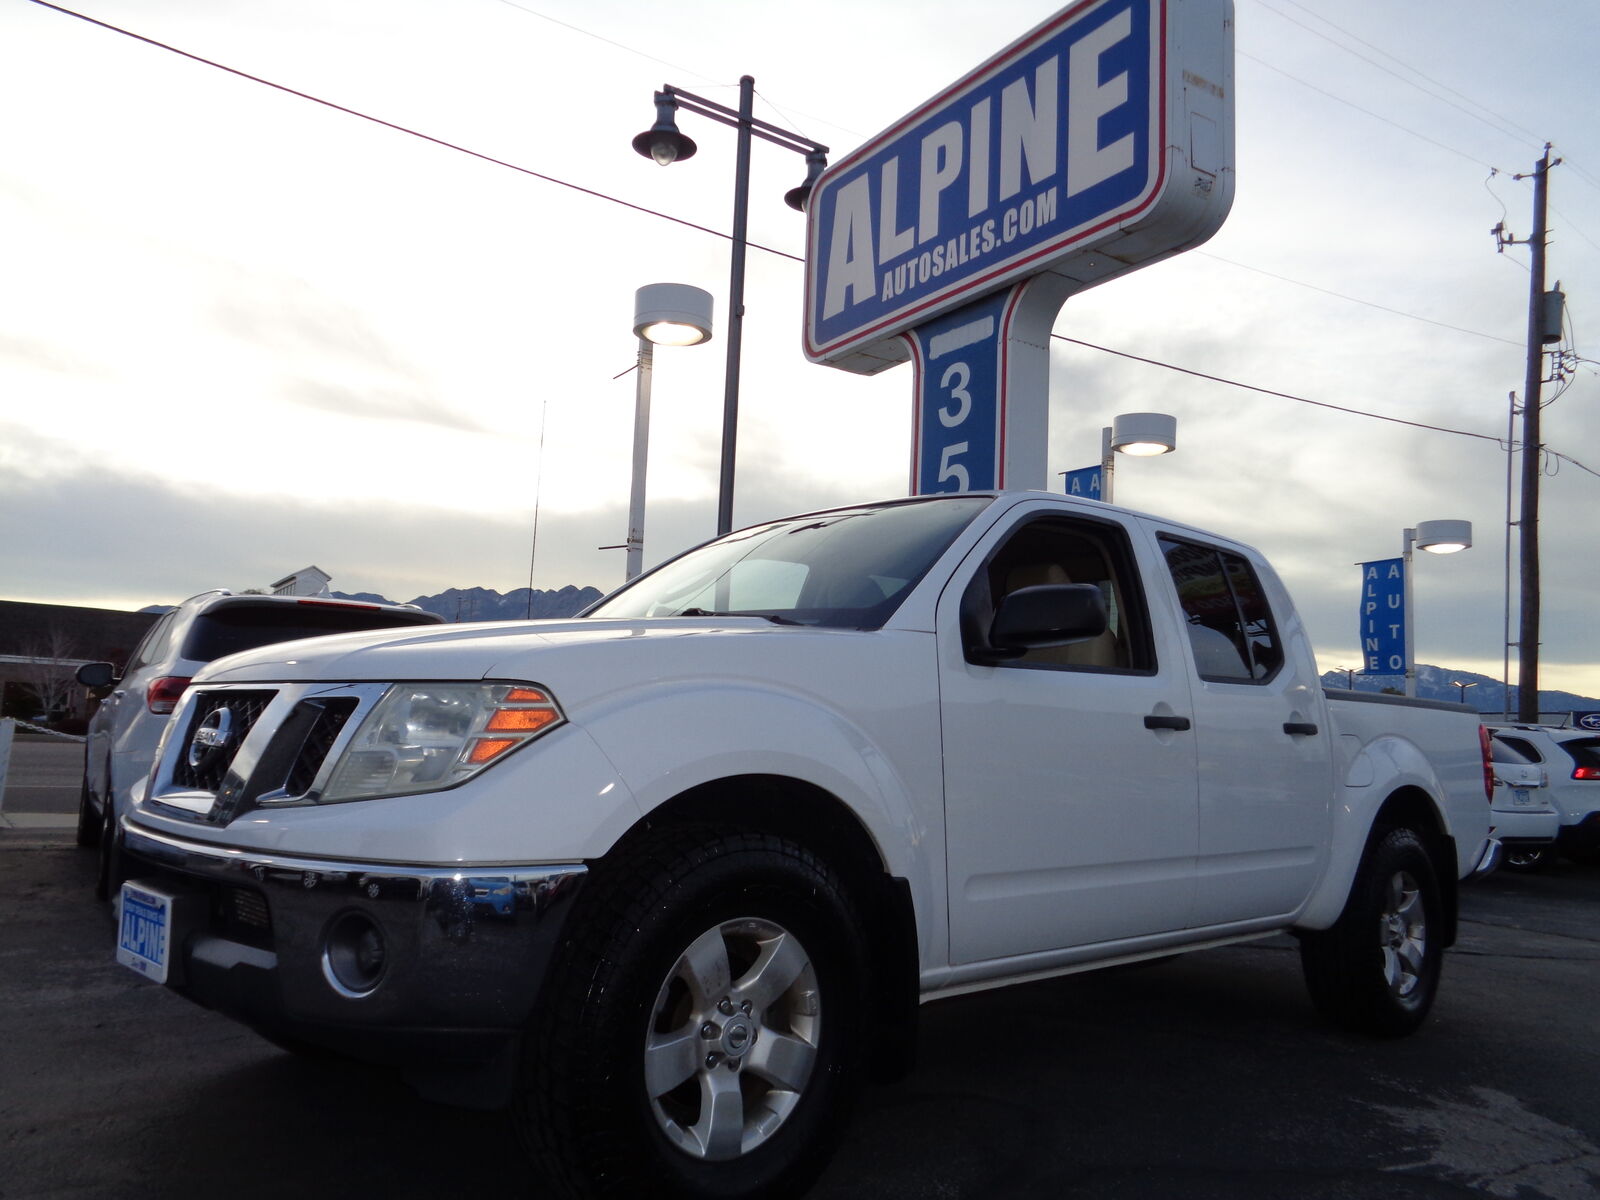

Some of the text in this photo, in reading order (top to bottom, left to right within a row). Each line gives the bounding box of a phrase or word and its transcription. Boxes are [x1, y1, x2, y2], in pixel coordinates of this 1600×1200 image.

[822, 6, 1135, 321] ALPINE
[881, 187, 1058, 303] AUTOSALES.COM
[1366, 566, 1379, 670] ALPINE
[1388, 564, 1403, 670] AUTO
[121, 911, 166, 966] ALPINE
